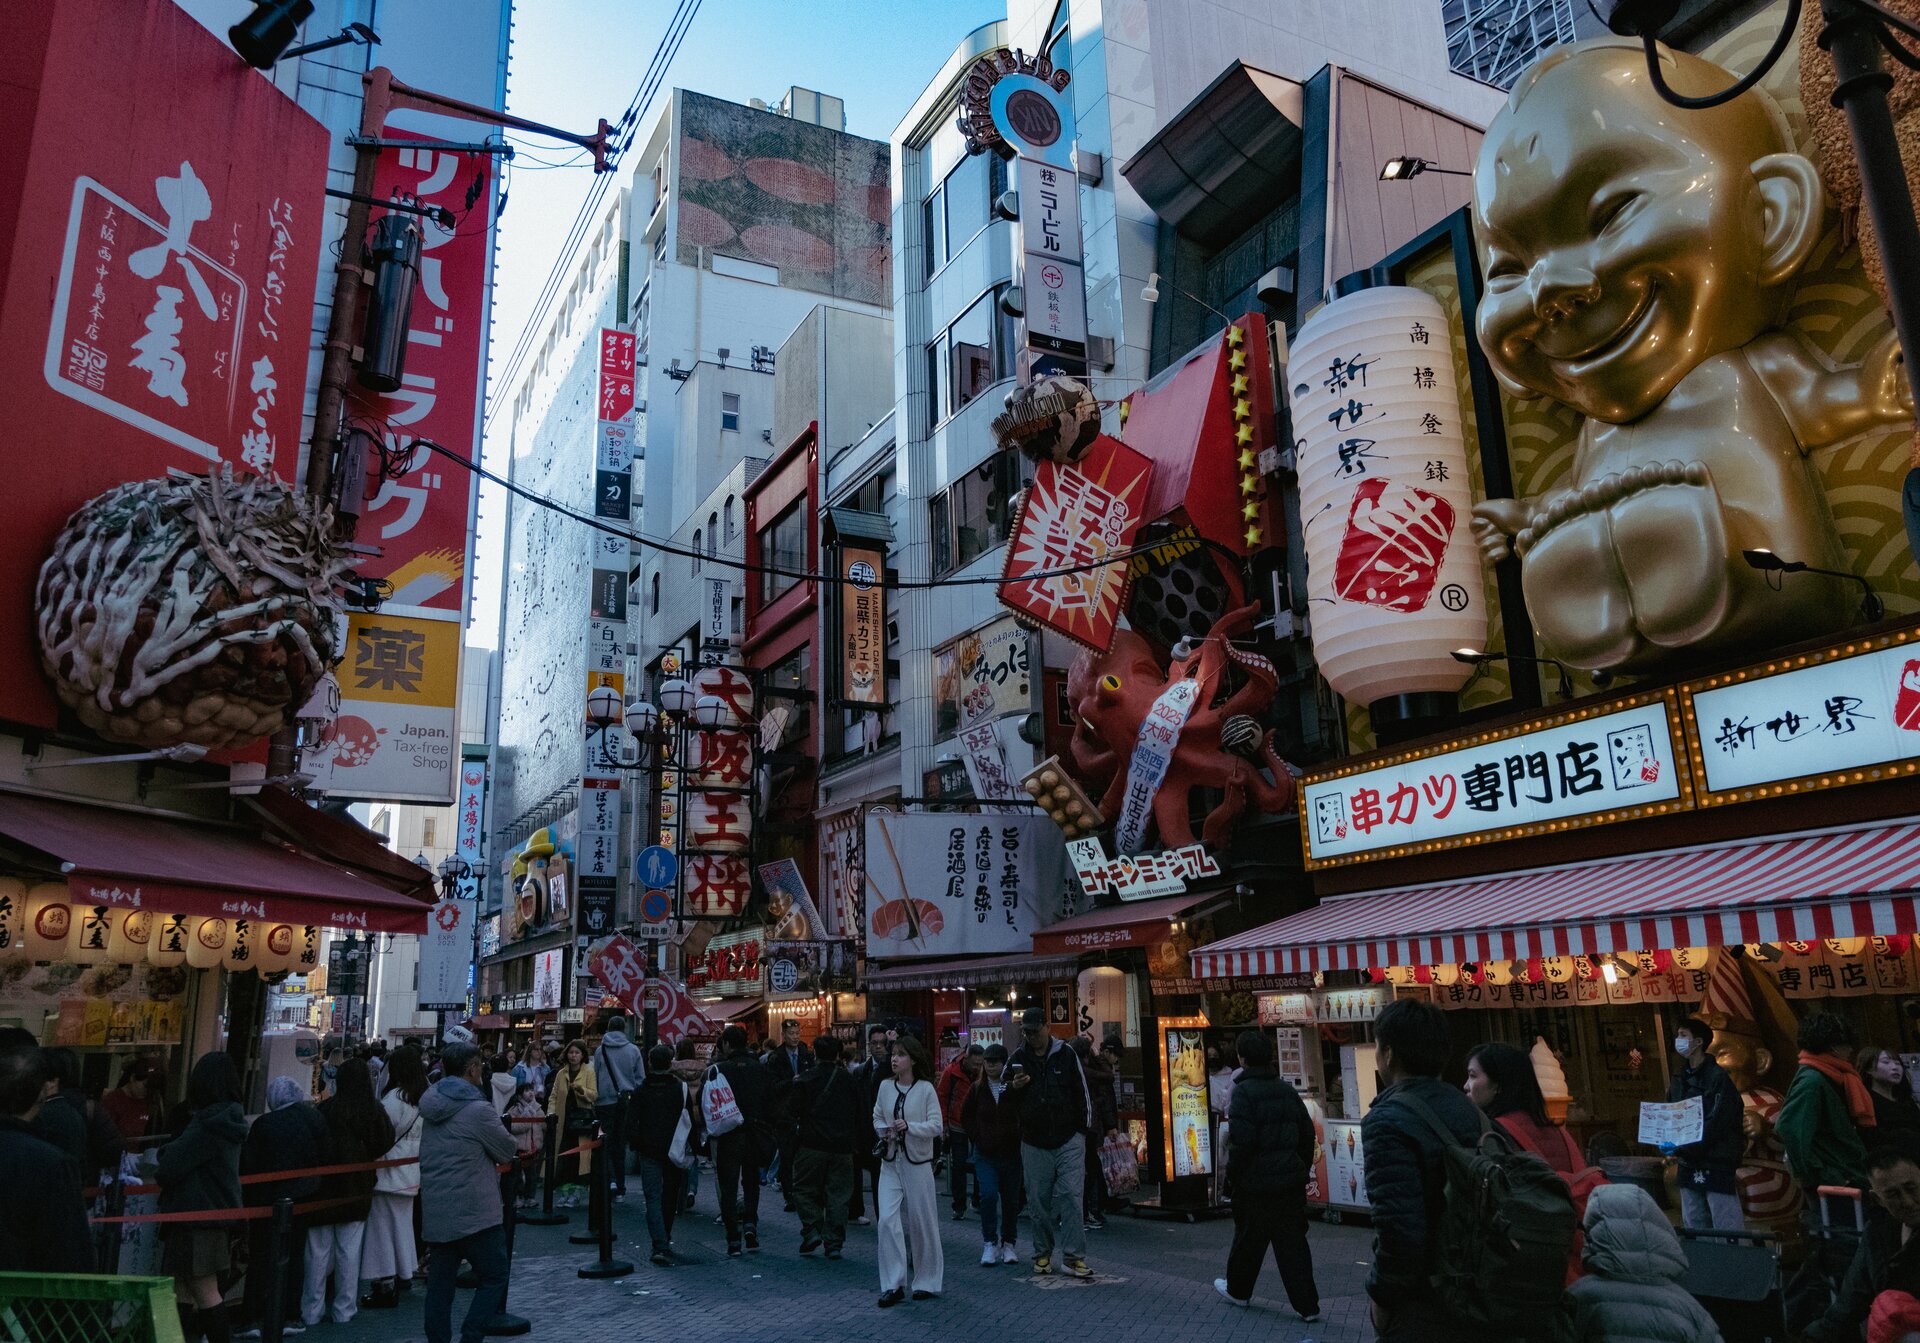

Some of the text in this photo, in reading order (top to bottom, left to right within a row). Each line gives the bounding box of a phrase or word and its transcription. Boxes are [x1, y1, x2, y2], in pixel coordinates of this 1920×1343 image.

[228, 222, 243, 267] じゅう
[84, 206, 118, 340] 大阪西中島本店
[220, 292, 233, 321] はち
[620, 336, 634, 371] ダーツ
[1050, 339, 1062, 348] 4F
[212, 350, 228, 380] ばん
[602, 334, 619, 421] ダイニングバー
[619, 383, 632, 396] &
[1409, 321, 1450, 484] 商標登録
[622, 415, 633, 424] 9F
[1323, 352, 1389, 479] 新世界
[591, 622, 601, 630] 4F
[856, 596, 870, 661] 豆柴カフェ
[872, 593, 880, 646] MAMESHIBA
[354, 626, 426, 693] 薬
[1152, 703, 1185, 726] 2025
[1713, 695, 1877, 758] 新世界
[399, 723, 449, 740] Japan.
[1146, 721, 1172, 745] 大阪
[393, 738, 449, 755] Tax-free
[1135, 746, 1166, 769] 関西
[412, 754, 448, 771] Shop
[1131, 761, 1164, 784] 万博
[596, 781, 608, 789] 2F
[1350, 740, 1604, 835] 串カツ専門店
[461, 792, 480, 851] 本場の味
[1118, 782, 1151, 851] 出店決定
[945, 827, 966, 898] 居酒屋
[974, 825, 993, 924] 産直の魚の
[1079, 849, 1217, 893] コナモンミュージアム
[999, 826, 1020, 933] 旨い寿司と、
[641, 925, 668, 936] 自動車
[1205, 978, 1231, 992] 自由席
[1233, 976, 1298, 990] Free eat in space
[1449, 980, 1570, 1003] 串カツ専門店
[1776, 963, 1868, 991] 専門店
